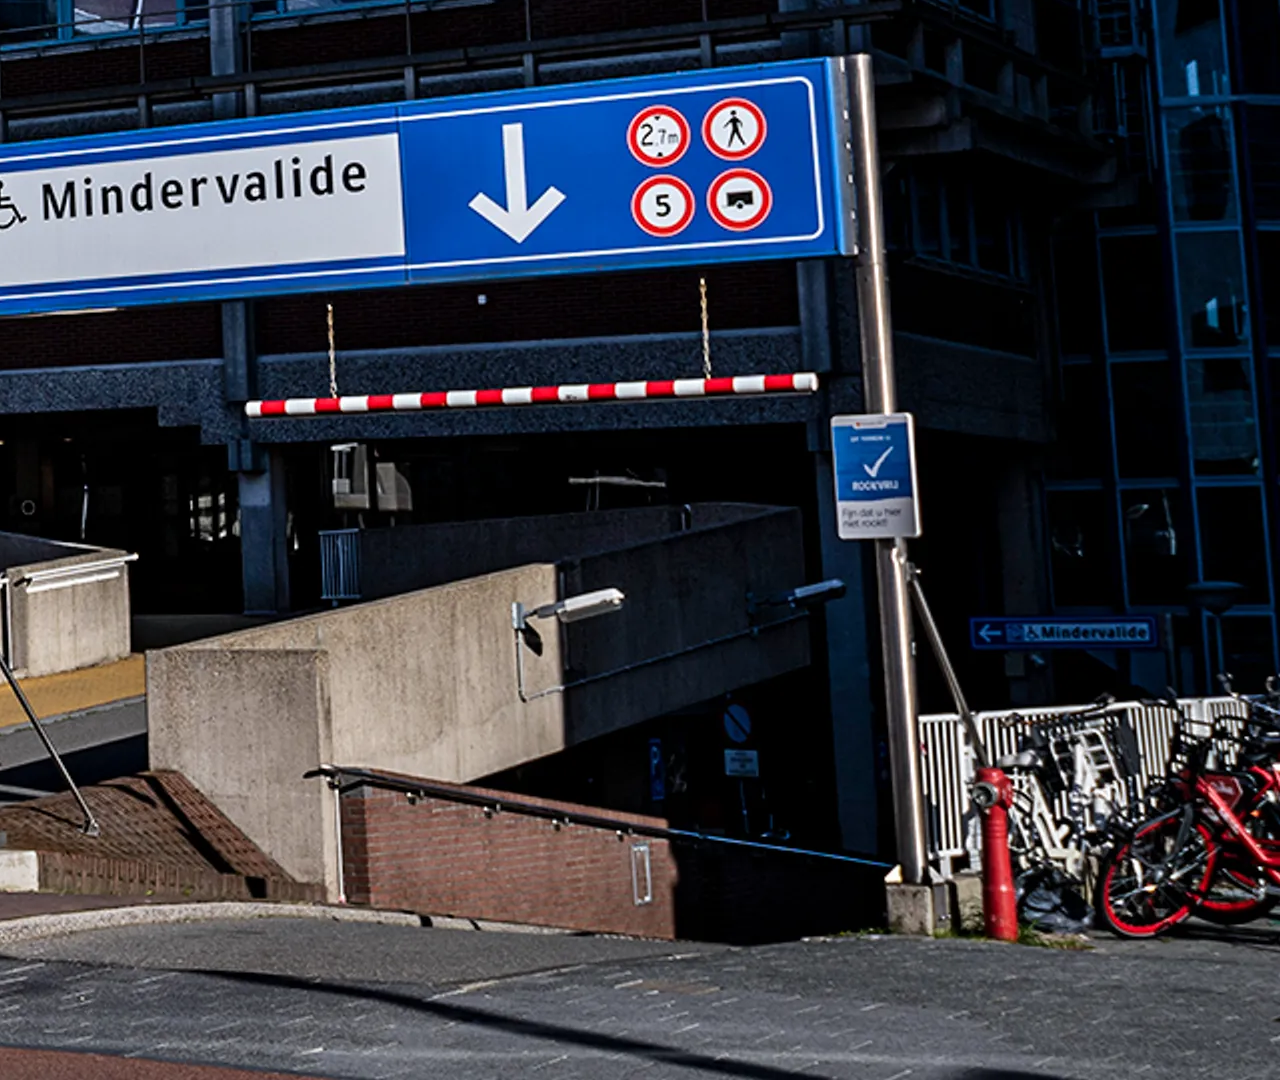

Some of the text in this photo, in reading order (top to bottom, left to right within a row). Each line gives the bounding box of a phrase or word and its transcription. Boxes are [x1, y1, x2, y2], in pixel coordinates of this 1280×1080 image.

[42, 155, 368, 220] Mindervalide
[656, 194, 671, 217] 5
[1042, 626, 1148, 640] Mindervalide
